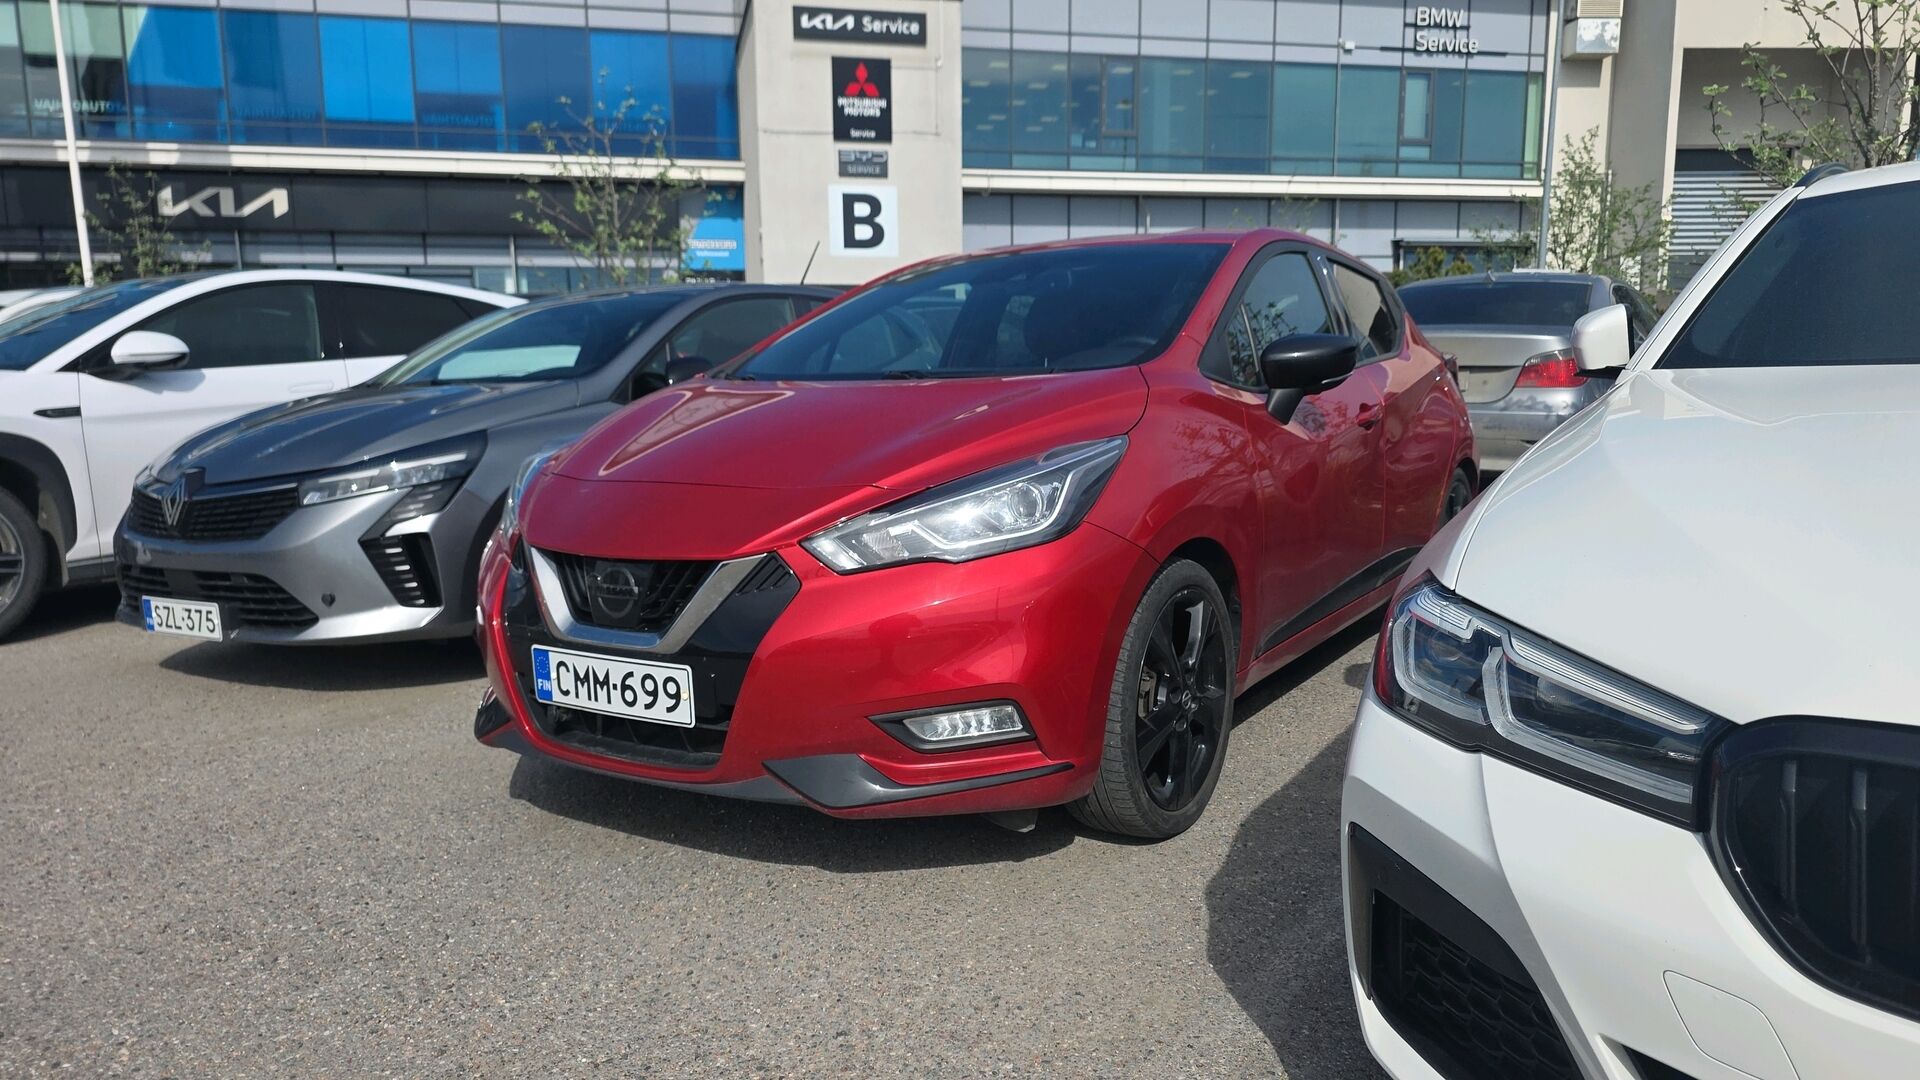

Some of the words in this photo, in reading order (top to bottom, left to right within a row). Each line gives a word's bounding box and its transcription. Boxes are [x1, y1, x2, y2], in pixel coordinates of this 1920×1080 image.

[800, 12, 855, 31] KIA
[861, 15, 920, 35] Service
[1415, 6, 1465, 27] BMW
[1415, 31, 1480, 54] Service
[837, 95, 887, 109] MITSUBISHI
[843, 106, 881, 117] MOTORS
[849, 128, 876, 139] Service
[839, 150, 888, 163] BYD
[847, 164, 881, 175] SERVICE
[157, 184, 290, 219] KIA
[842, 192, 885, 249] B
[154, 604, 216, 633] SZL-375
[537, 678, 552, 692] FIN
[555, 660, 682, 713] CMM-699
